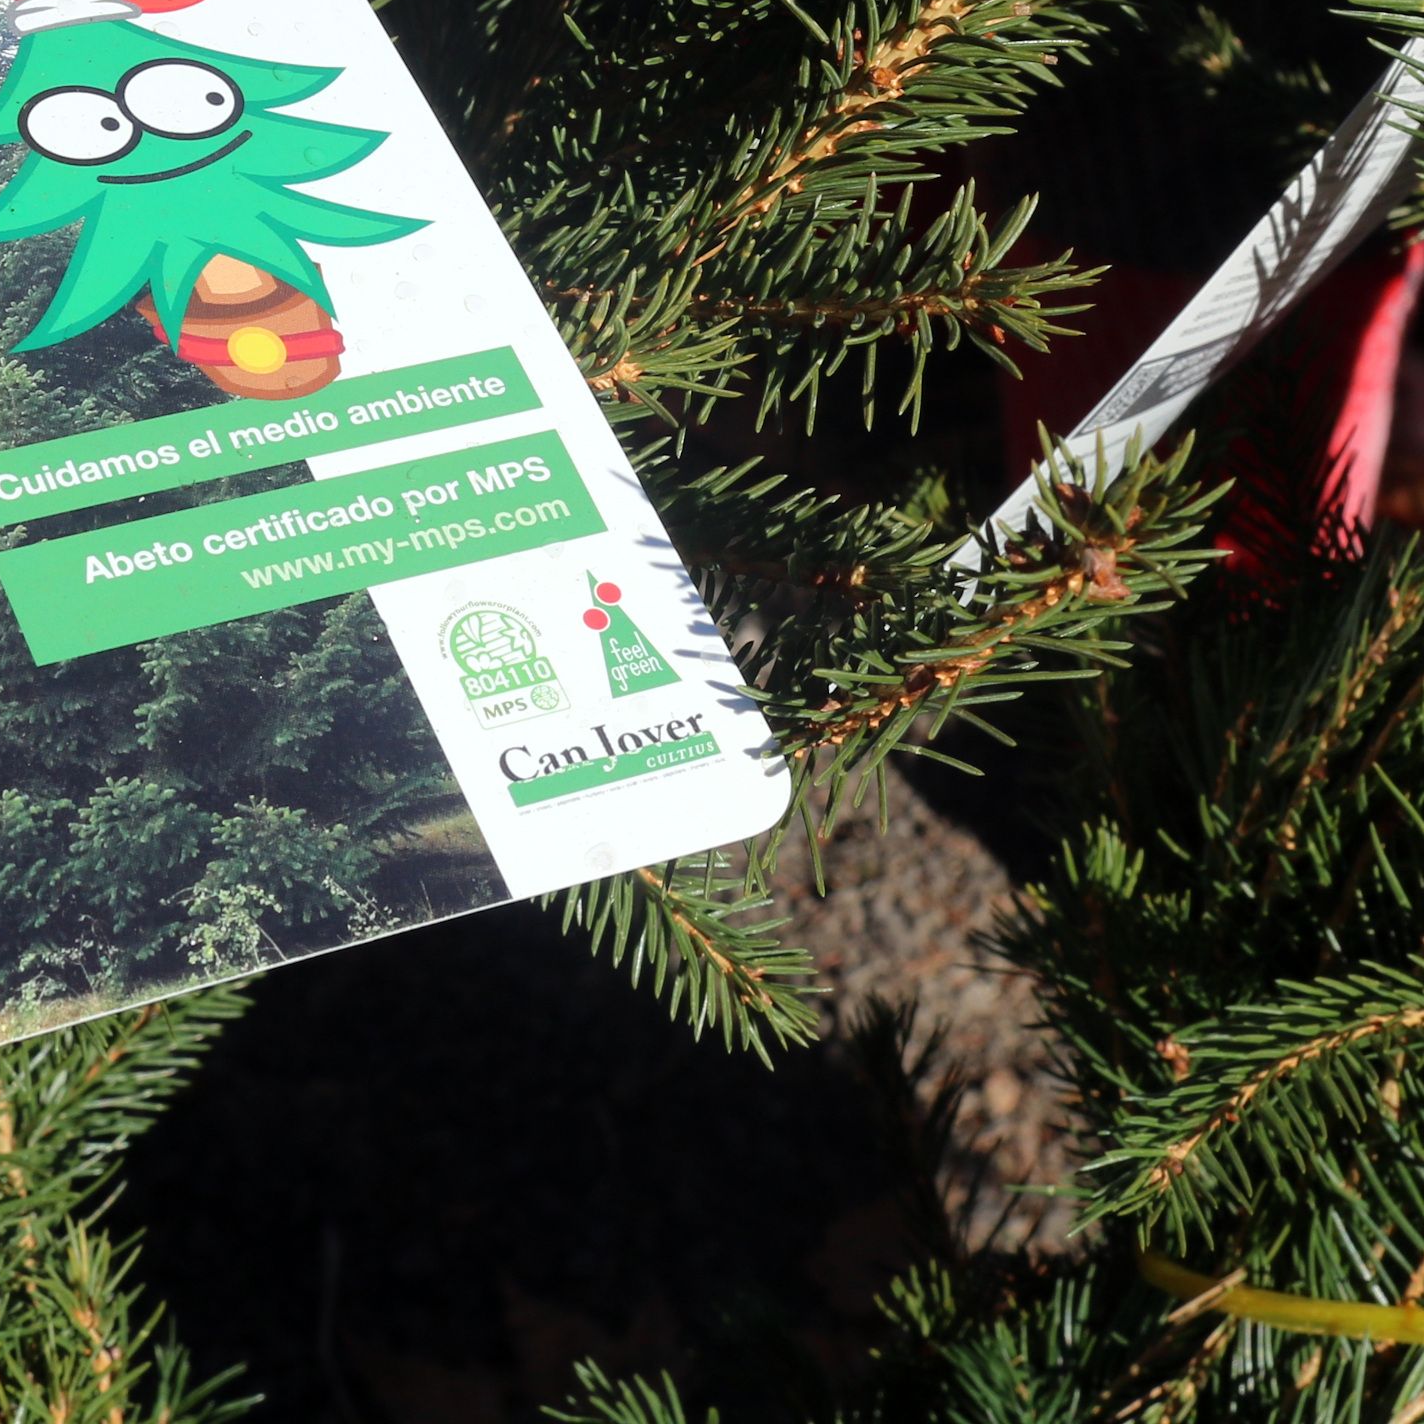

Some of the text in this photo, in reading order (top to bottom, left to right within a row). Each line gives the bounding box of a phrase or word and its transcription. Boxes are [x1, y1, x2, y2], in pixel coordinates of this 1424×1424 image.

[188, 429, 223, 459] el
[229, 411, 339, 450] medio
[347, 372, 507, 425] ambiente
[85, 455, 552, 585] Abeto certificado por MPS
[241, 499, 571, 589] www.my-mps.com
[610, 631, 648, 662] feel
[465, 659, 551, 696] 804110
[611, 655, 663, 692] green
[482, 697, 528, 720] MPS
[498, 713, 703, 783] Can Jover
[646, 741, 715, 768] CULTIUS
